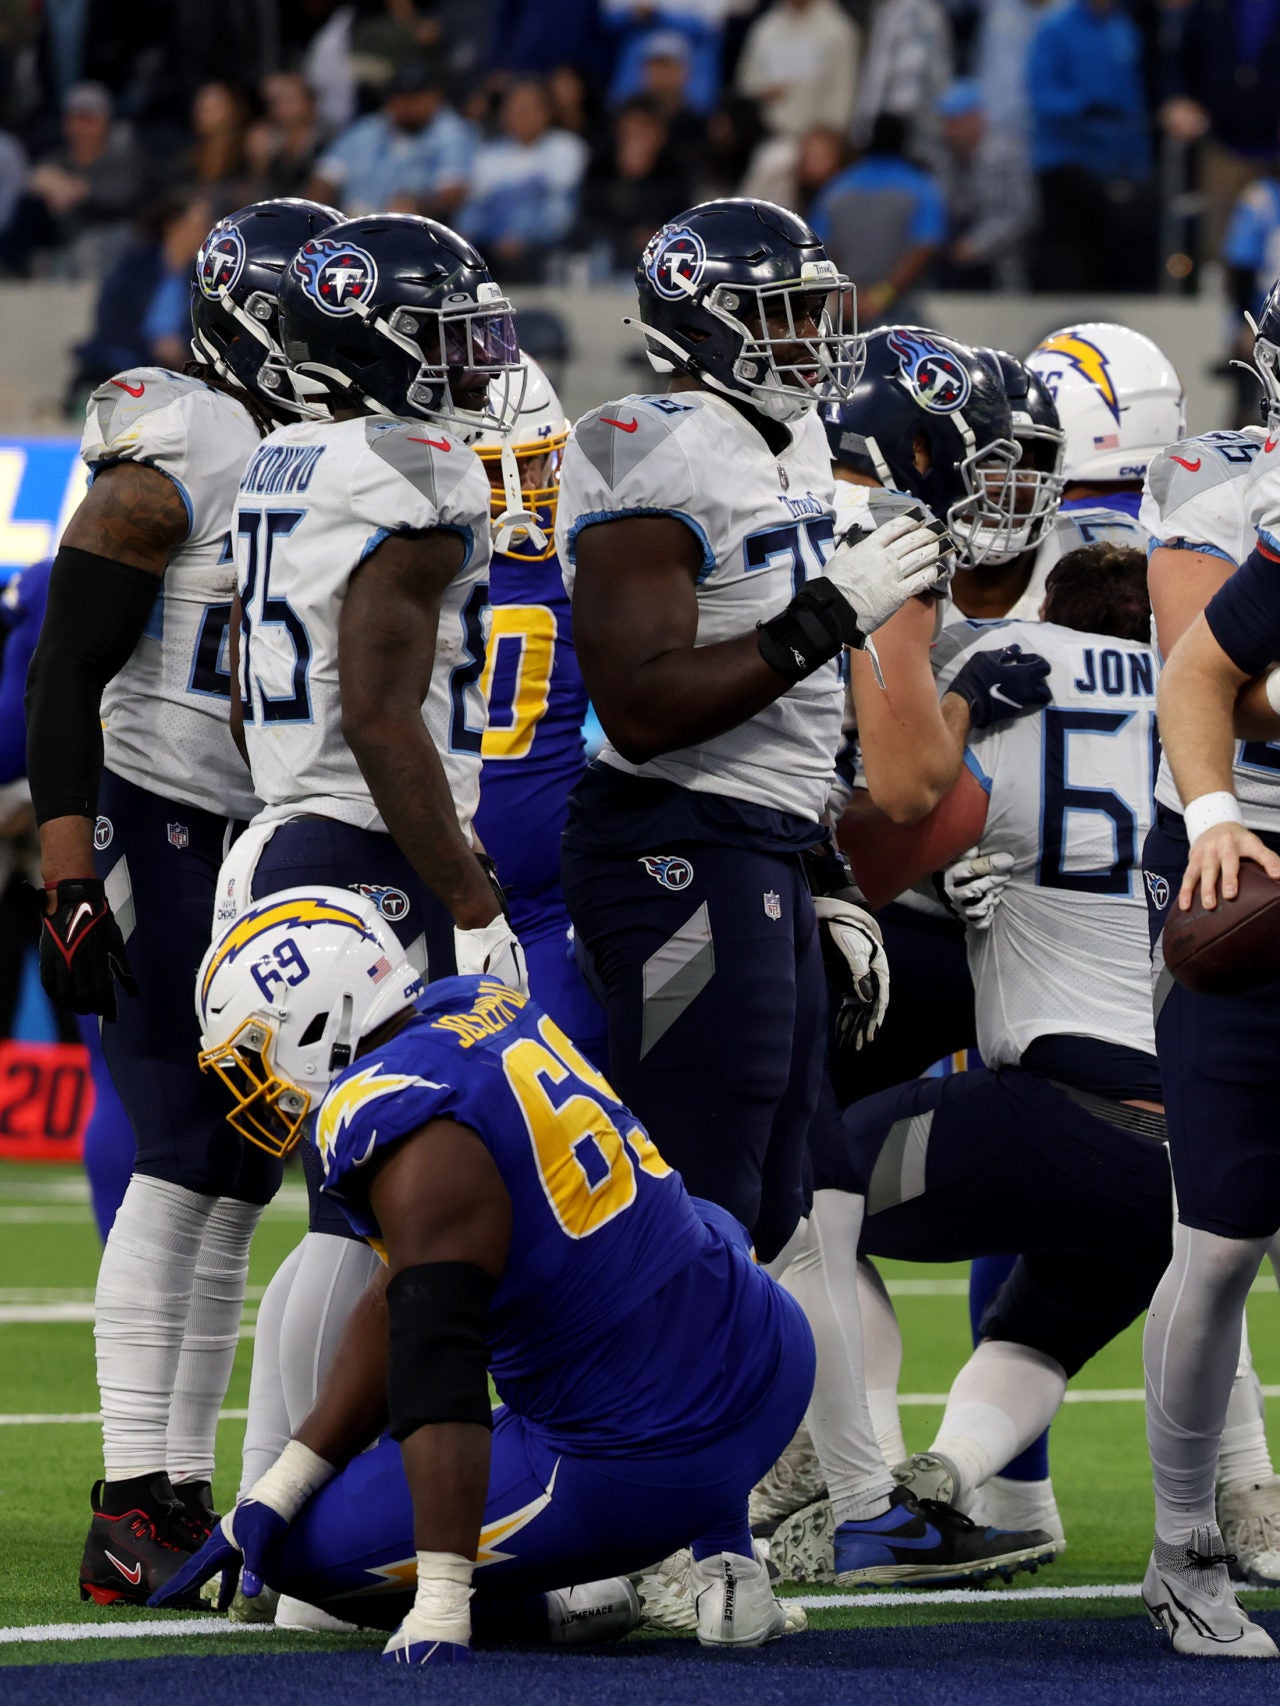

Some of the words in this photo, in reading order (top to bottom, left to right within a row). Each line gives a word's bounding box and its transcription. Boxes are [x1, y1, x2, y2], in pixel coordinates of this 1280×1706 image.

[1035, 705, 1161, 899] 6
[249, 937, 311, 1004] 69
[0, 1061, 86, 1139] 20
